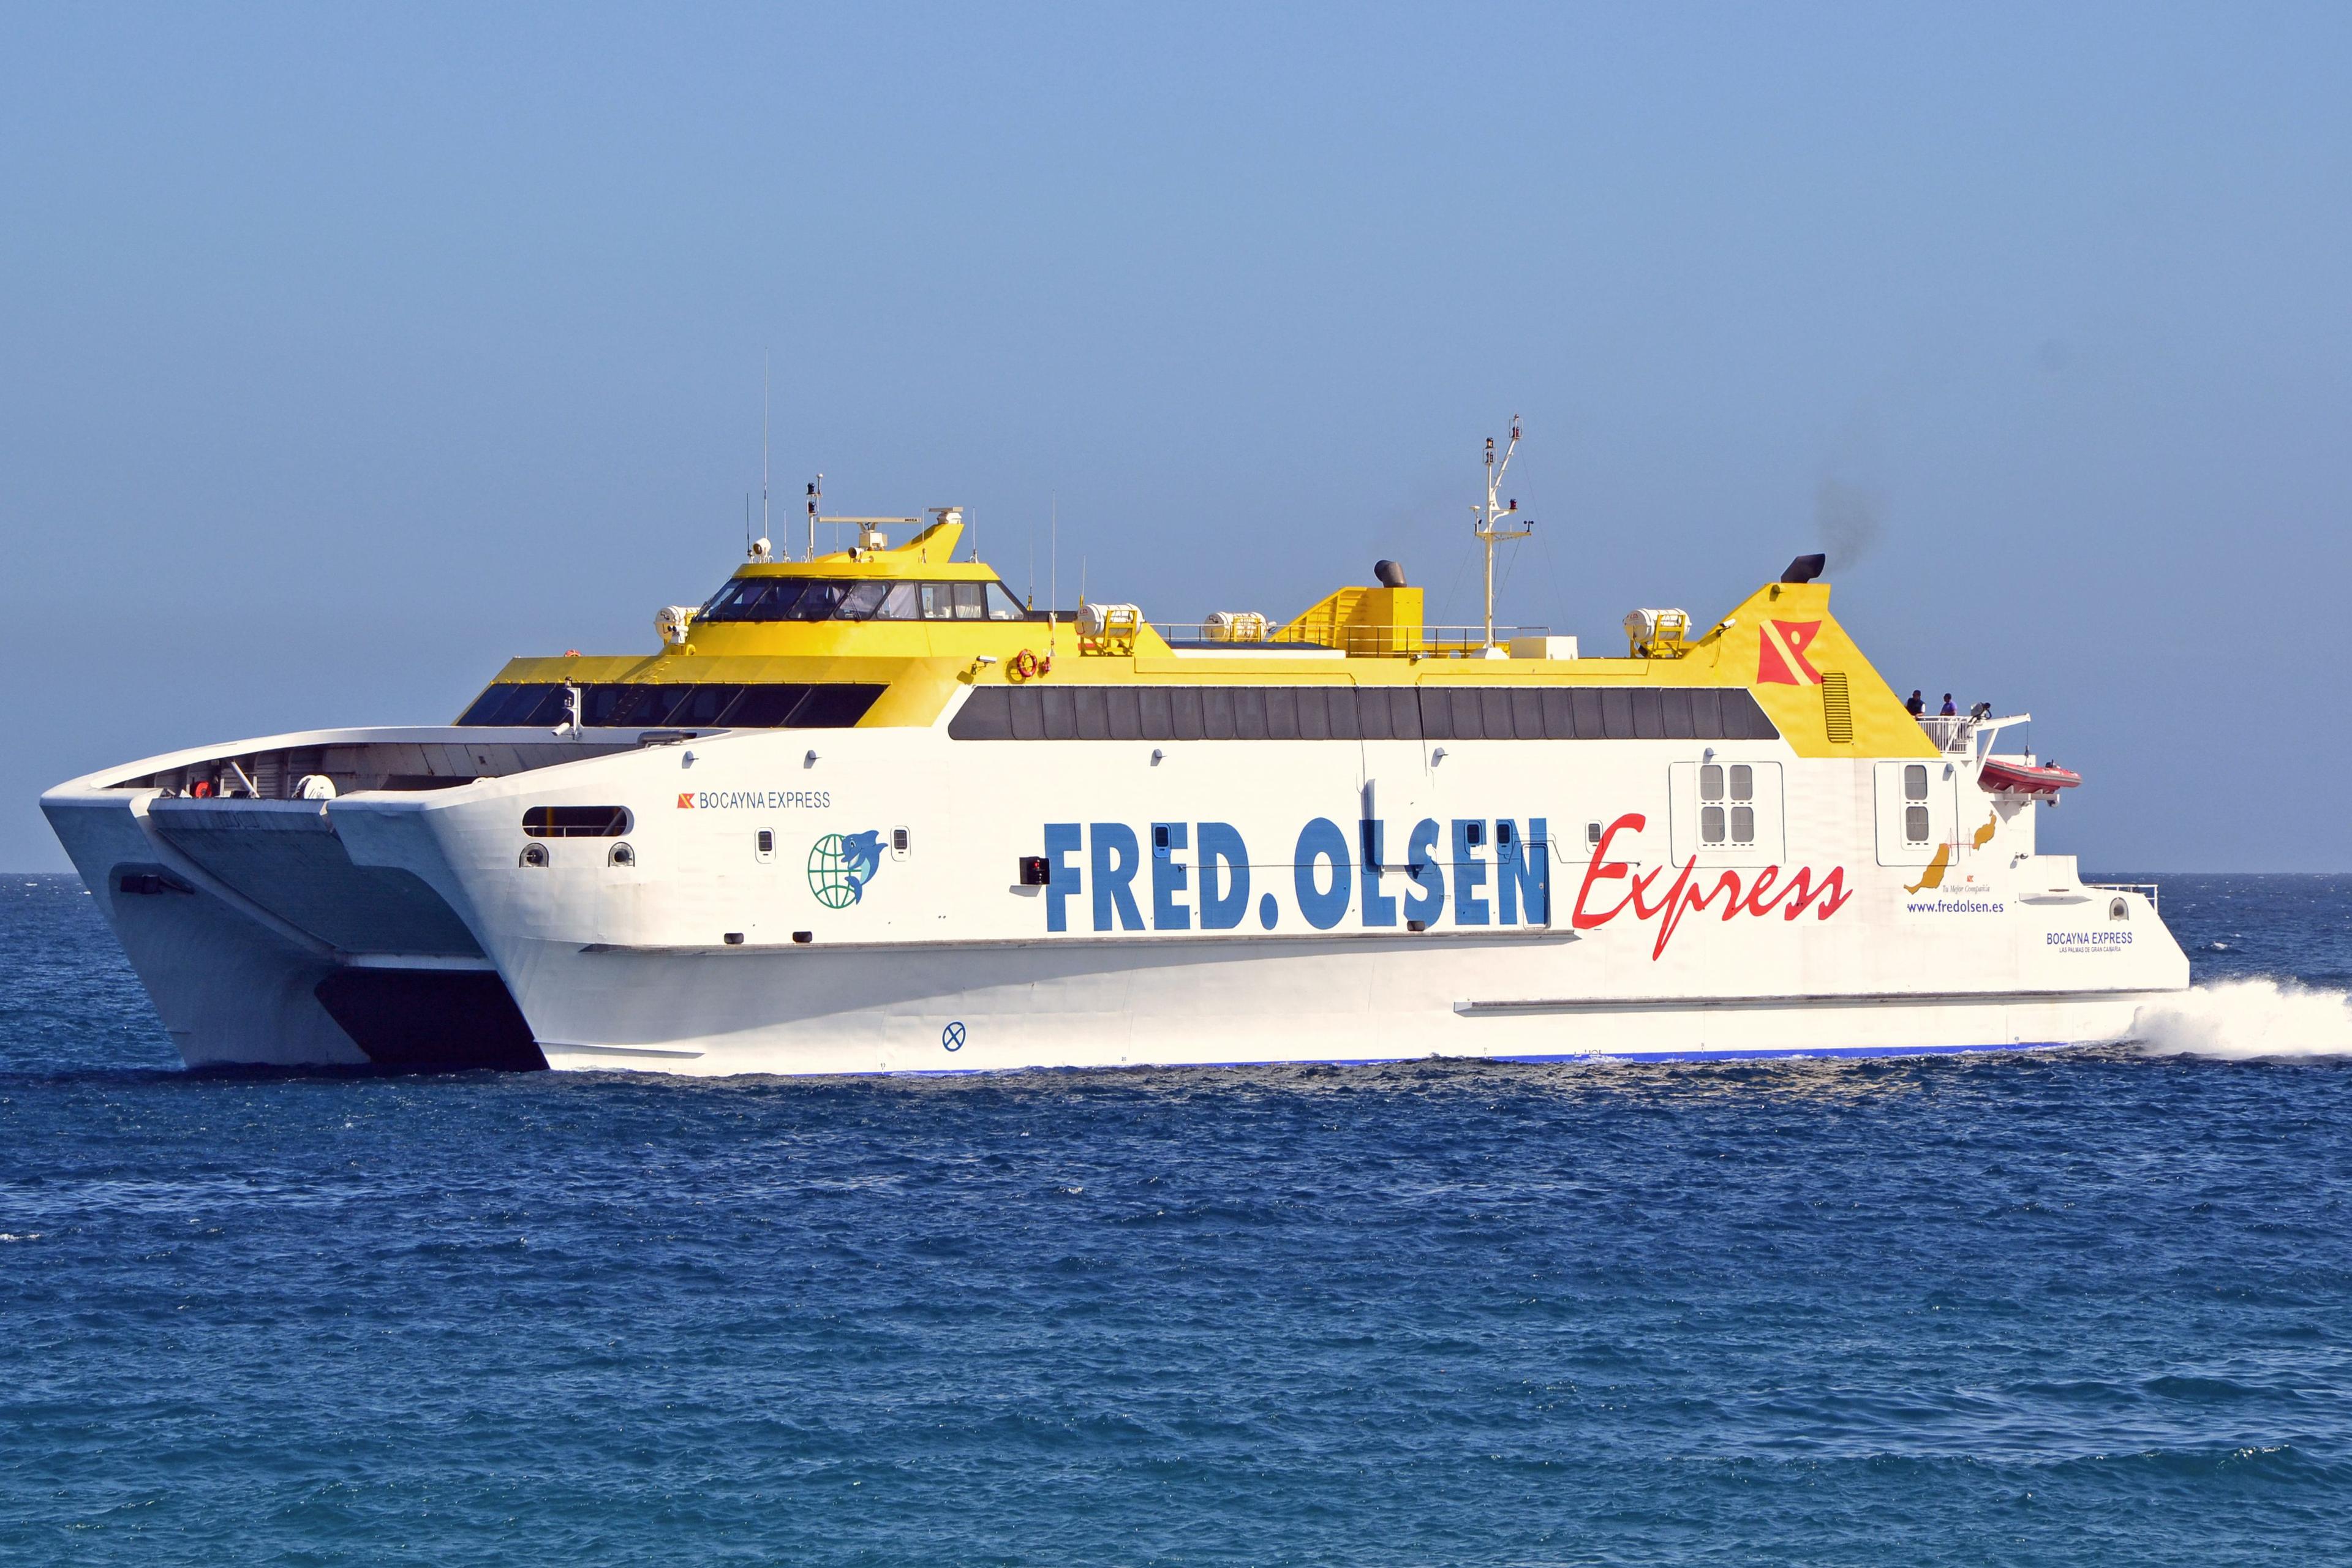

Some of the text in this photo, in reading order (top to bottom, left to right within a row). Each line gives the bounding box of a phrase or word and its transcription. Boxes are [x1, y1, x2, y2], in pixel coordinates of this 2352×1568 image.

[700, 792, 831, 809] BOCAYNA EXPRESS
[1294, 817, 1548, 930] OLSEN
[1572, 813, 1853, 961] Express
[1907, 900, 2004, 913] www.fredolsen.es
[2047, 932, 2133, 944] BOCAYNA EXPRESS
